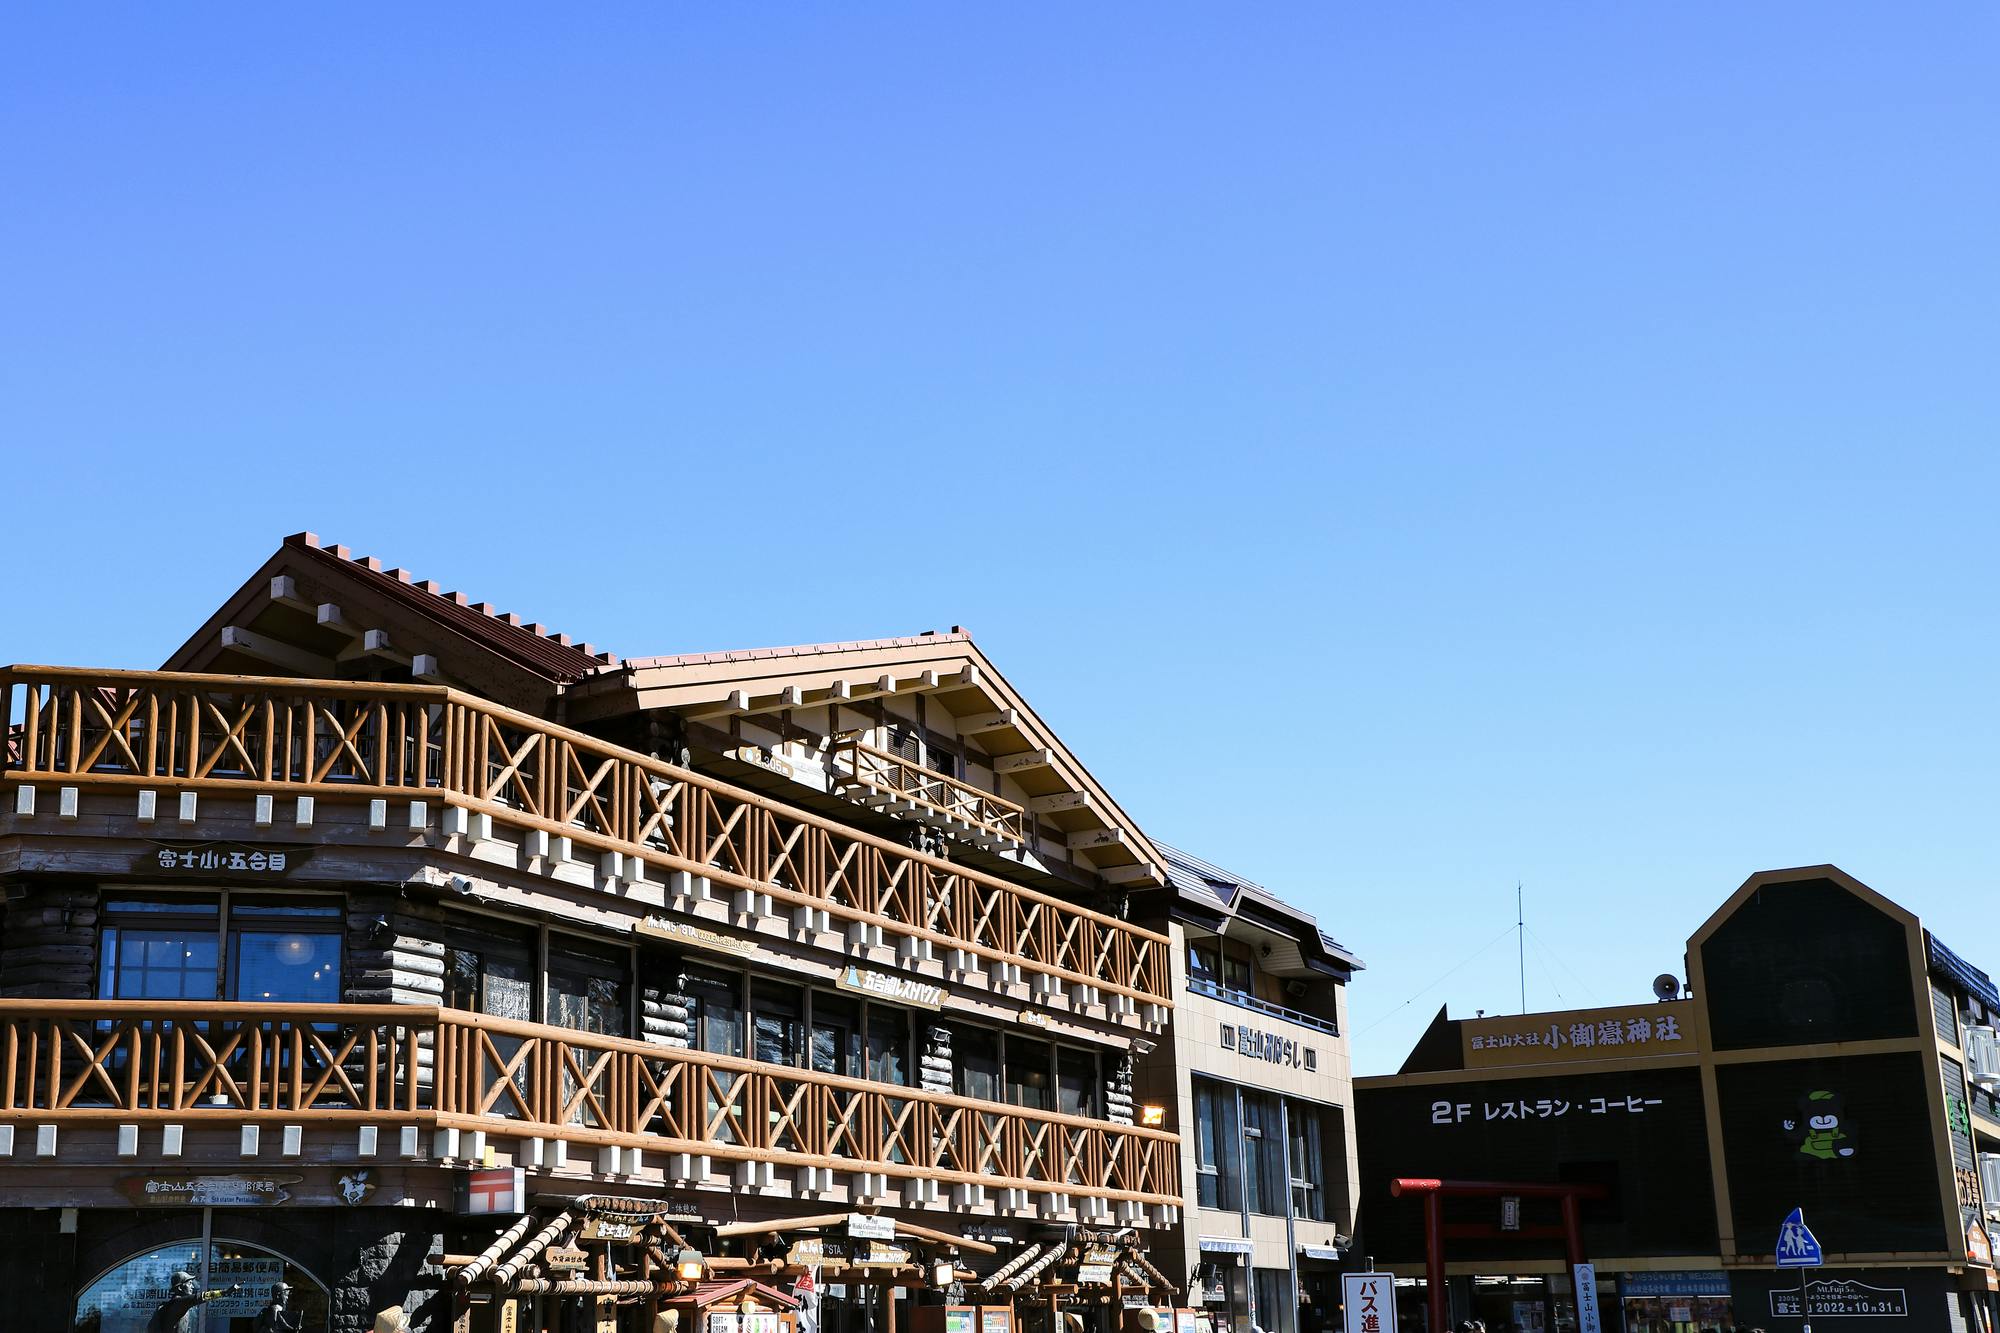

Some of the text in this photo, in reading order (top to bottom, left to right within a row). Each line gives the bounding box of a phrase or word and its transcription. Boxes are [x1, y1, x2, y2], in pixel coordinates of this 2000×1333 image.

[158, 848, 286, 871] 富士山・五合目
[1431, 1101, 1472, 1124] 2F
